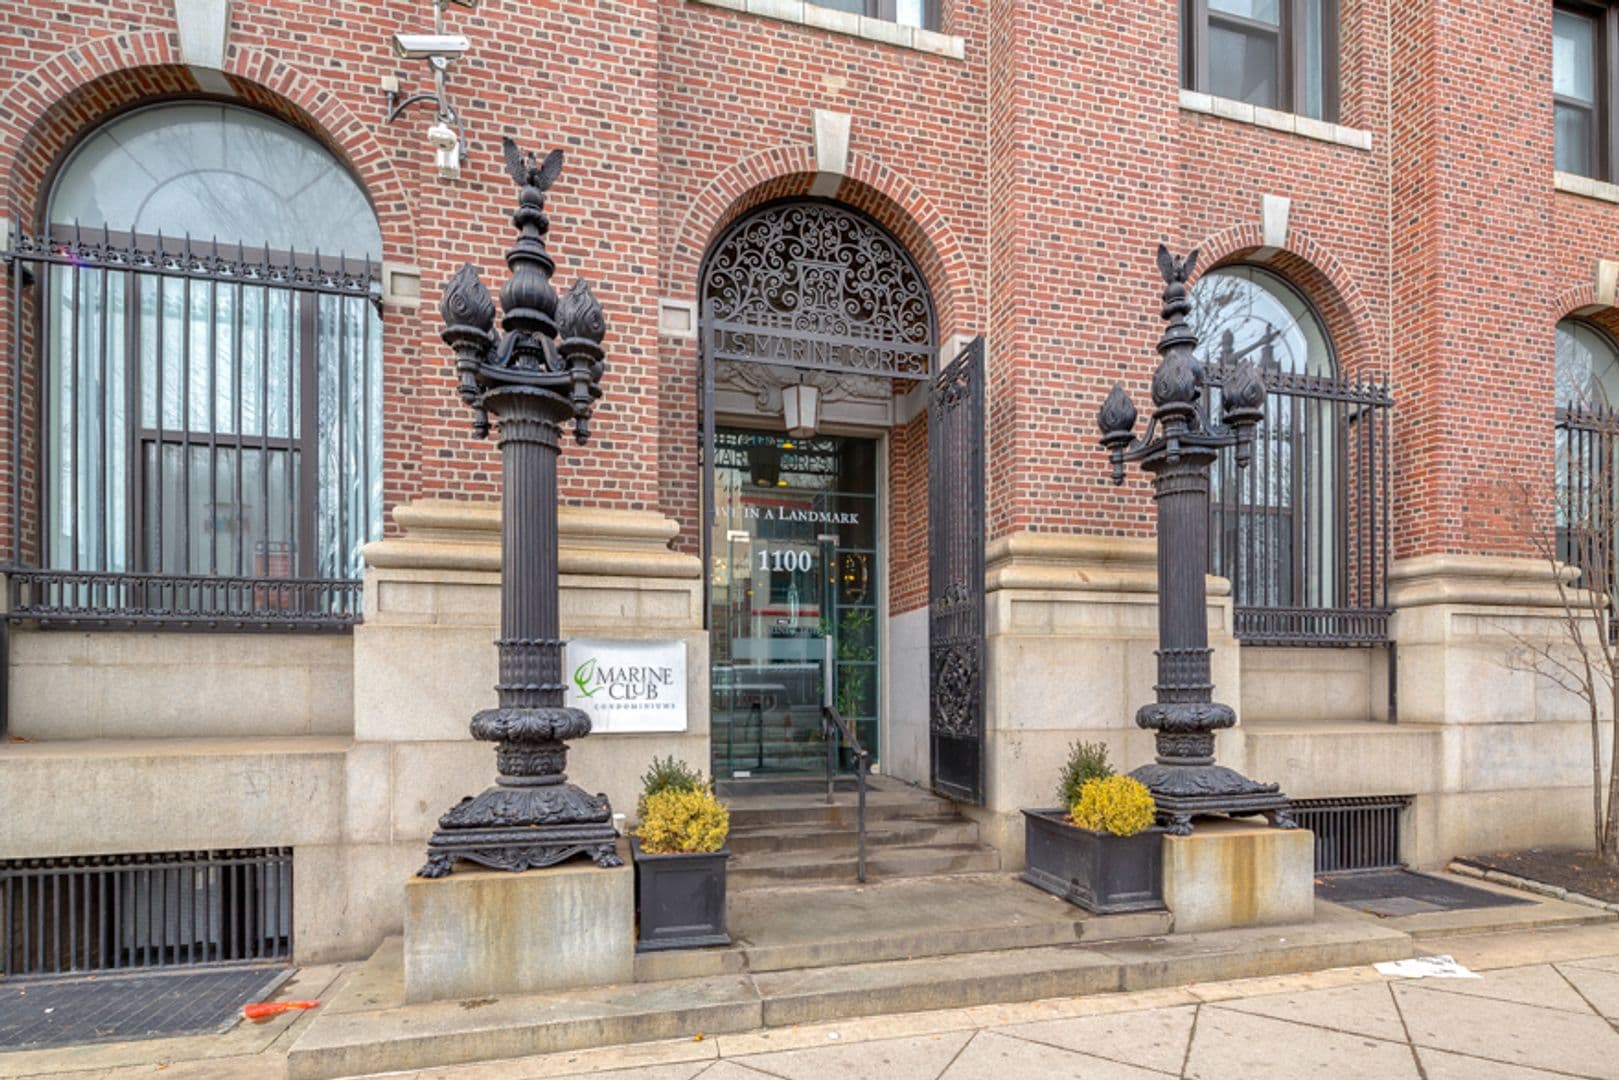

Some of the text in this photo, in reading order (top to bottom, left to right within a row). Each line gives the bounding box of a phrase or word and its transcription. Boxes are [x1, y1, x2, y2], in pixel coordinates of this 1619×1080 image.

[755, 333, 842, 365] MARINE
[849, 346, 922, 374] CORPS
[744, 507, 759, 519] IN
[764, 510, 775, 520] A
[778, 505, 860, 524] LANDMARK
[758, 549, 812, 572] 1100
[595, 666, 674, 685] MARINE
[608, 681, 659, 700] CLUB
[594, 703, 676, 711] CONDOMINIUMS
